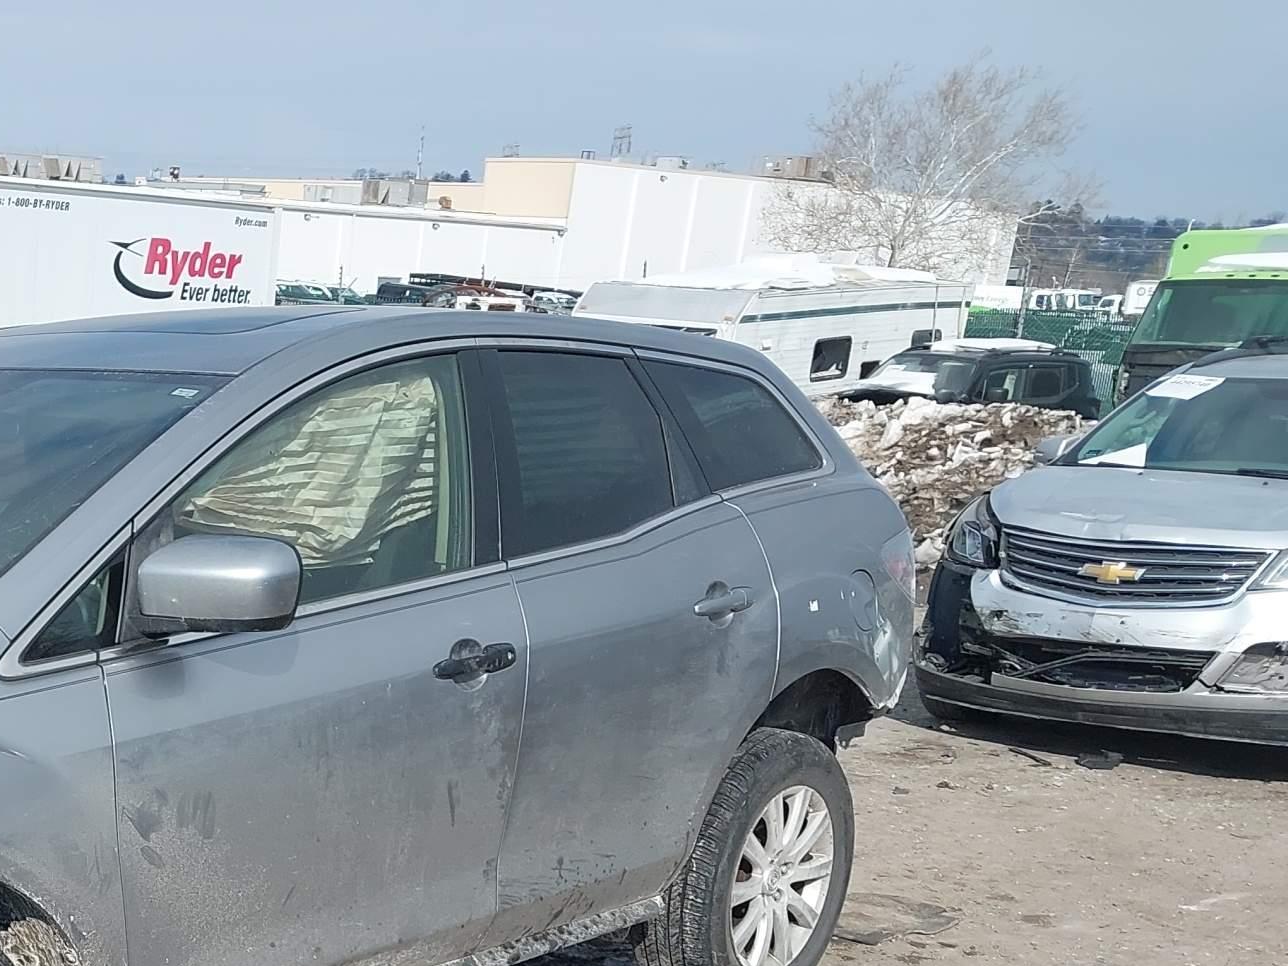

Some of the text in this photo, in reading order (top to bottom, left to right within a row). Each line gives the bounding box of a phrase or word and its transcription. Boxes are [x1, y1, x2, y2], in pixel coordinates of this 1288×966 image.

[7, 197, 71, 211] 1-800-BY-RYDER
[234, 216, 268, 228] Ryder.com
[144, 237, 243, 286] Ryder
[180, 282, 251, 304] Ever better.
